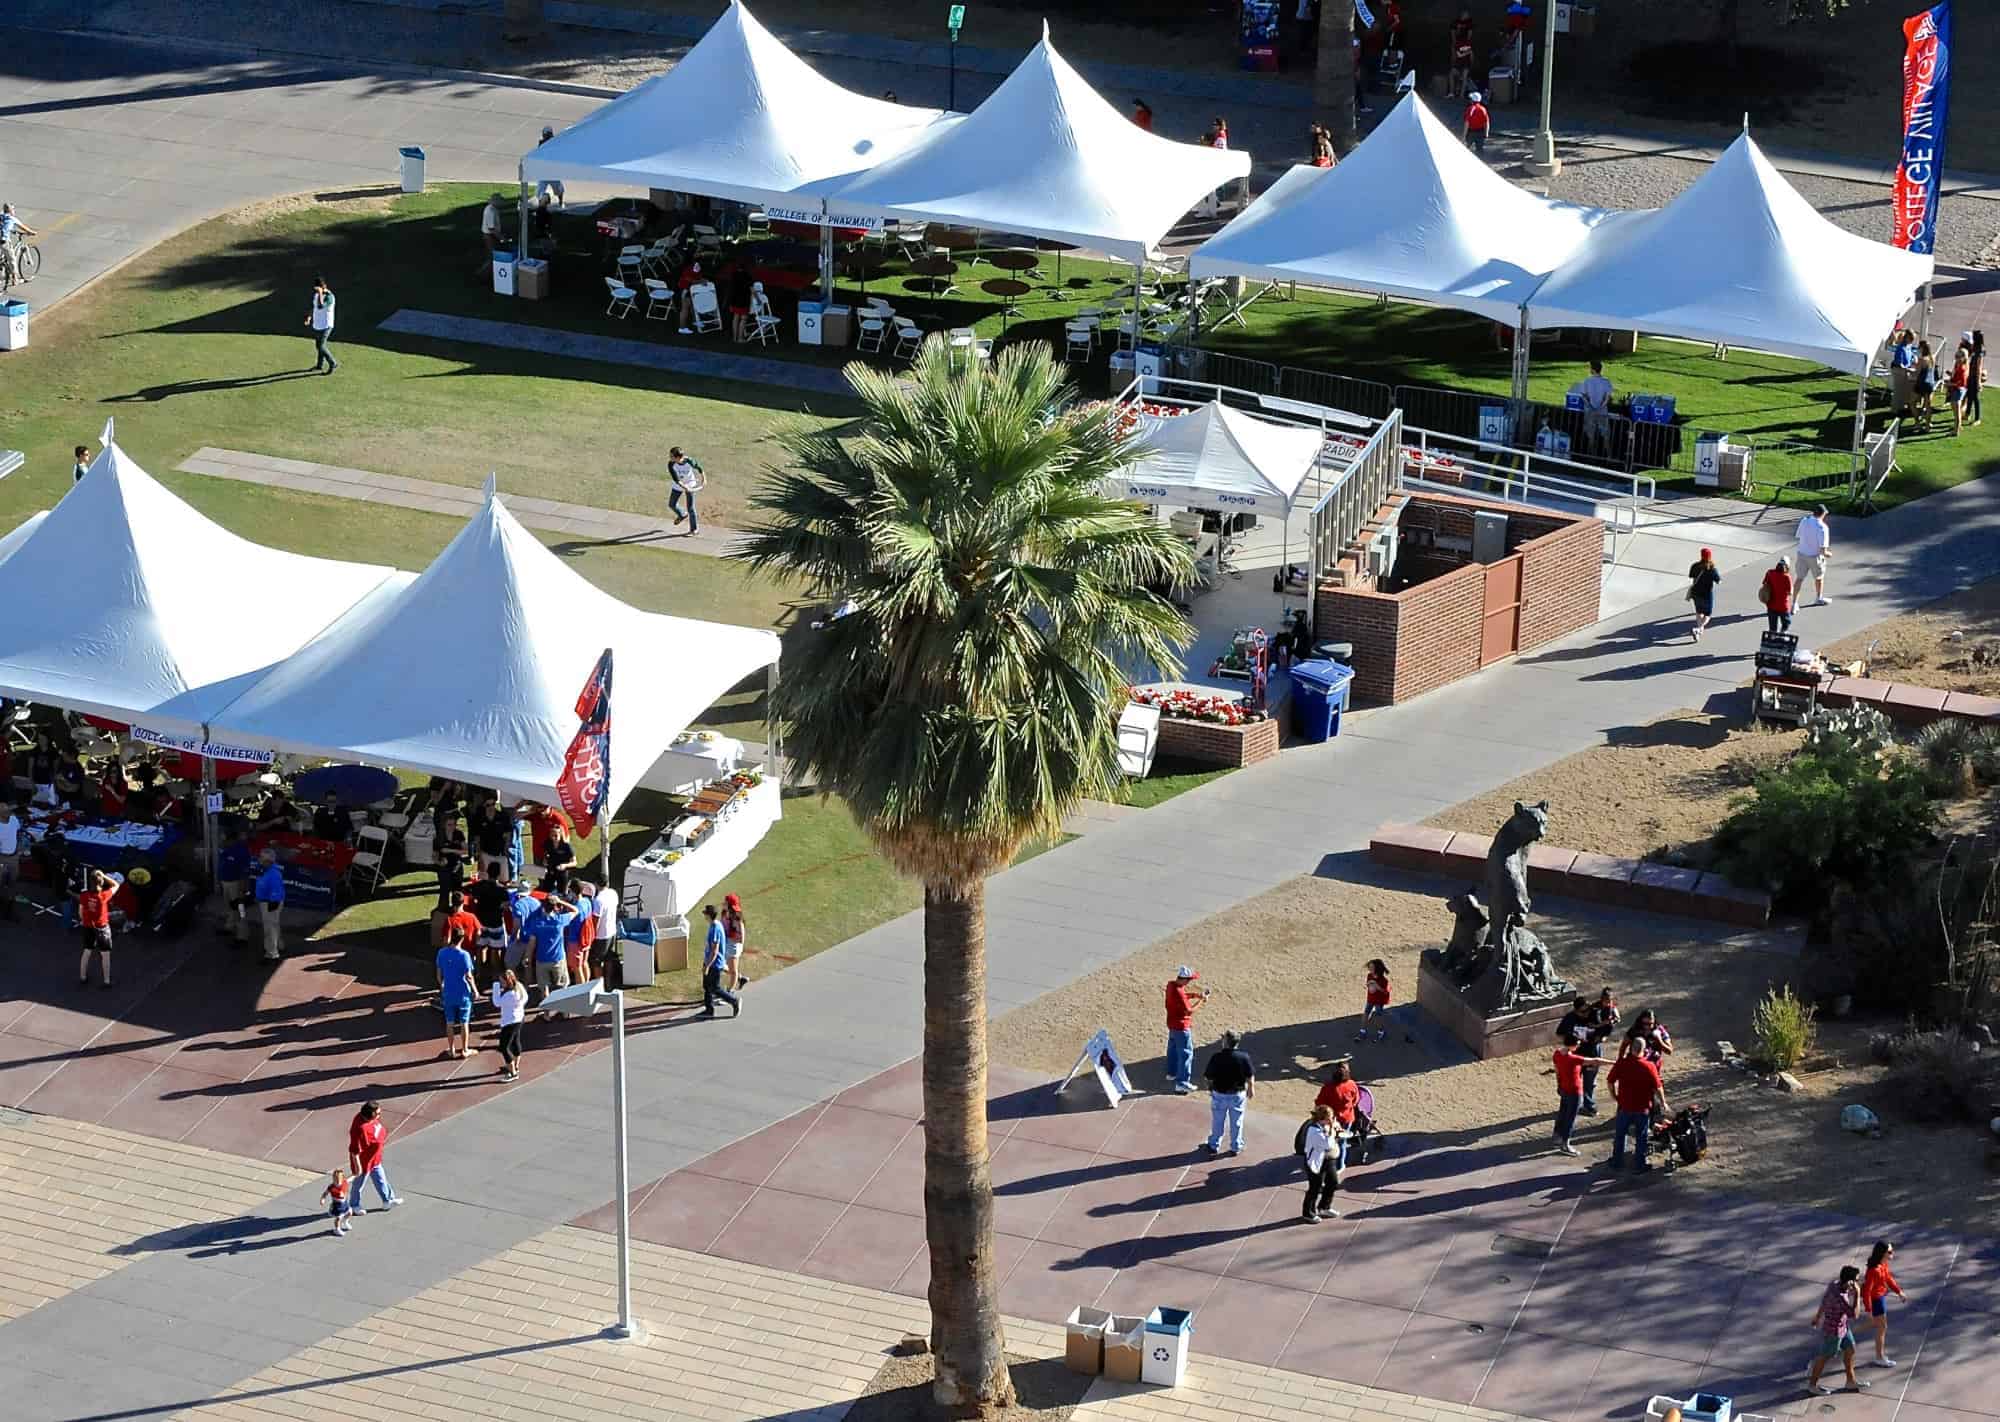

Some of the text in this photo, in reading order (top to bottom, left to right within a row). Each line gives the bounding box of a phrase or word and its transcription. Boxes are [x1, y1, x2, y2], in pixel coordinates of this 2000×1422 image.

[767, 207, 877, 227] COLLEGE OF PHARMACY
[1323, 443, 1357, 458] RADIO
[183, 741, 196, 750] OF
[201, 743, 271, 761] ENGINEERING
